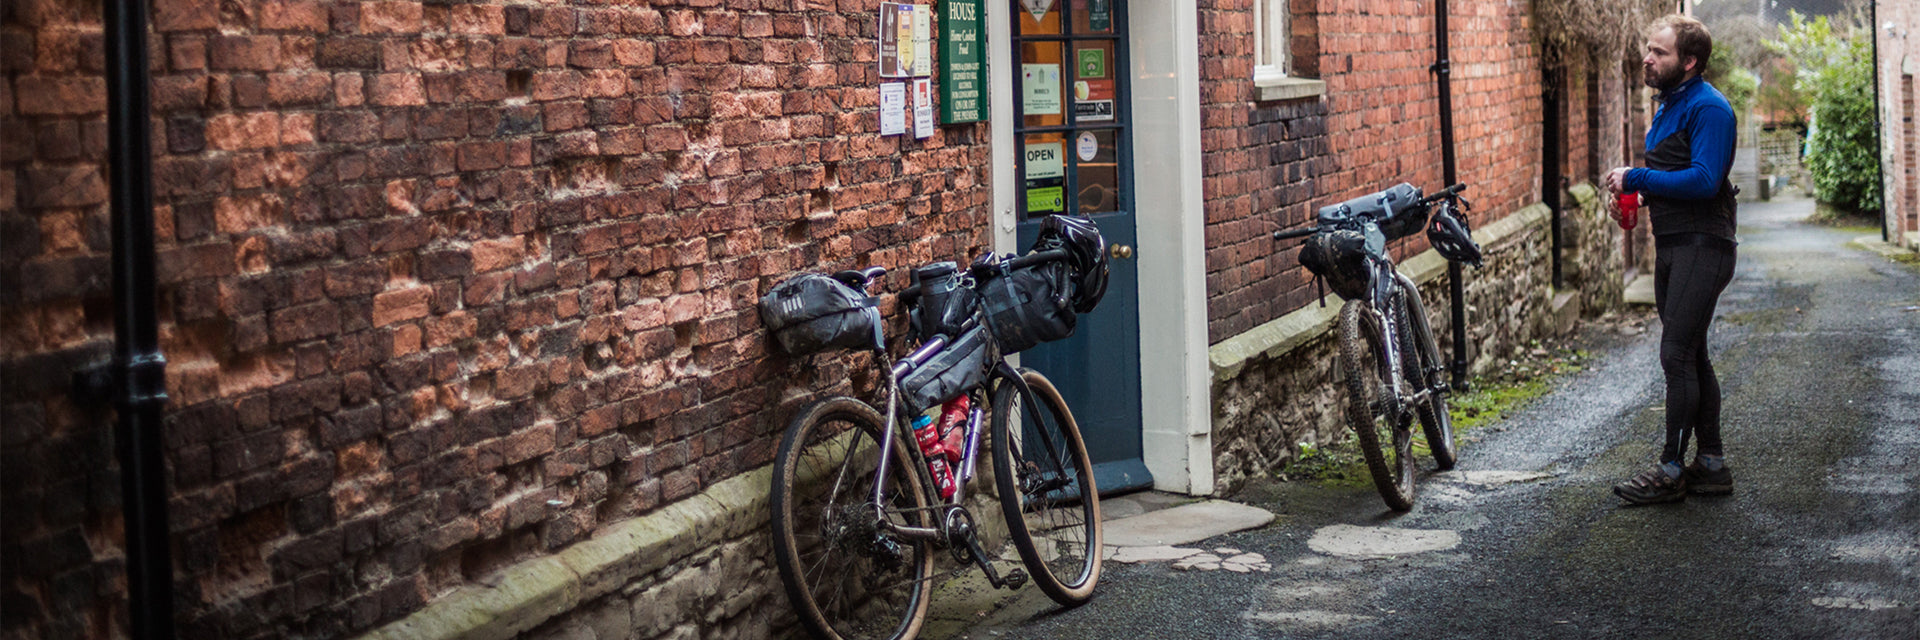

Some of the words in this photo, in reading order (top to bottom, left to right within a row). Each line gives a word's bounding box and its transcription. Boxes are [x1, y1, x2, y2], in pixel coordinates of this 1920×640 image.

[950, 2, 976, 20] HOUSE
[950, 30, 961, 41] Home
[961, 29, 976, 41] Cooked
[958, 42, 968, 54] Food
[955, 100, 961, 110] ON
[962, 100, 968, 110] OR
[961, 109, 979, 120] PREMISES
[1027, 149, 1054, 161] OPEN
